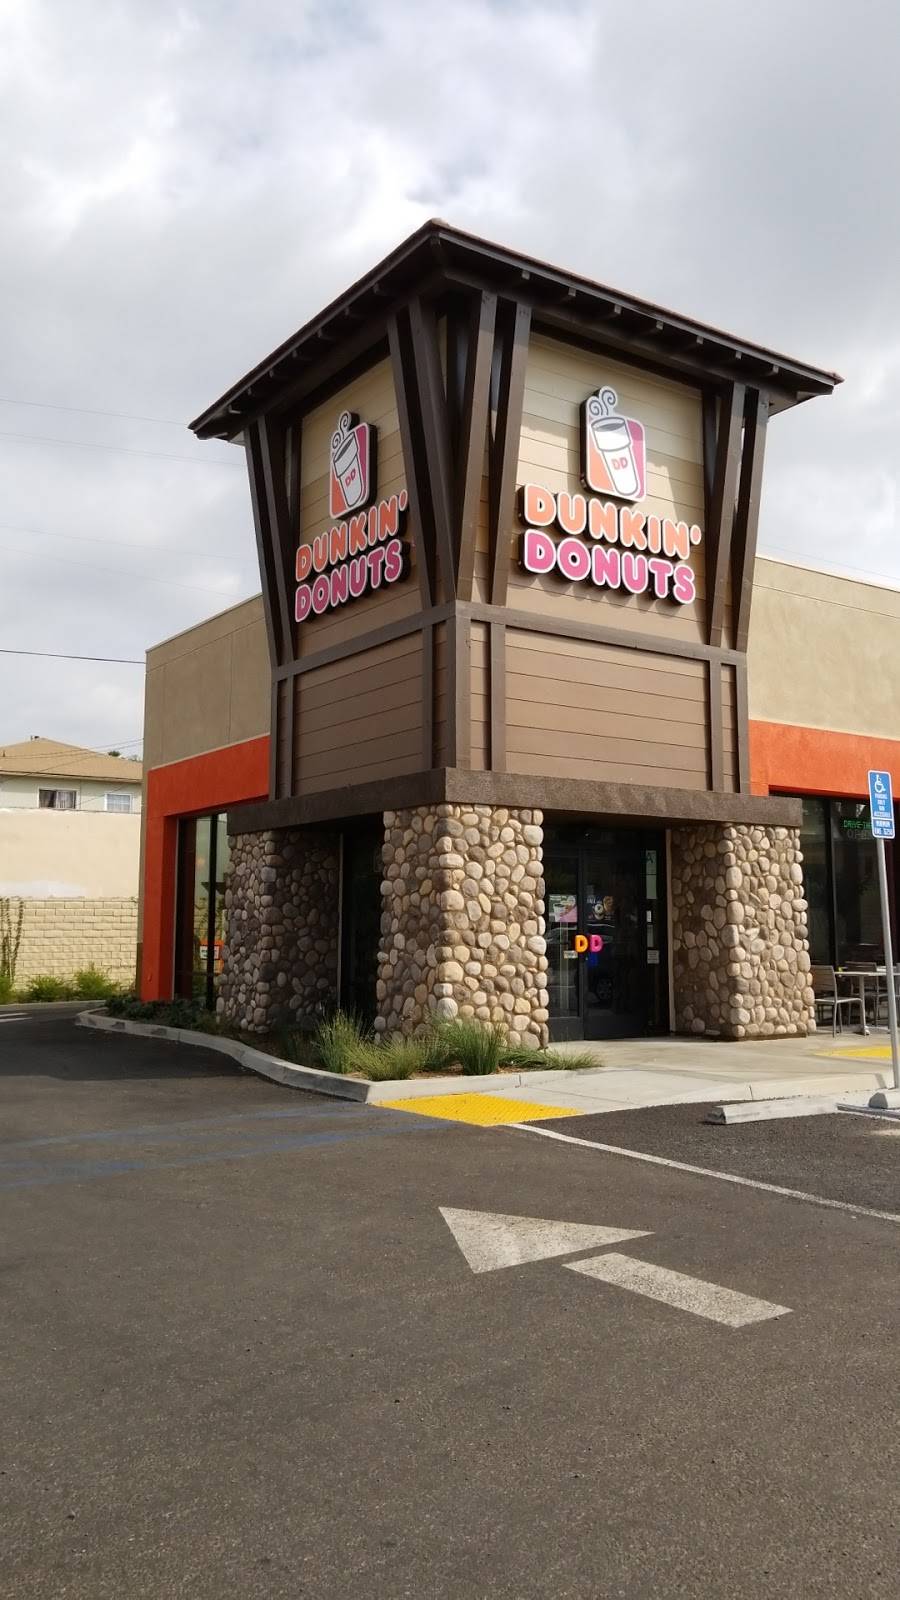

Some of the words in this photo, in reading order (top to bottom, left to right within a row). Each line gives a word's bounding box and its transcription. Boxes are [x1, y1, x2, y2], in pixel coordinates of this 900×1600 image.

[345, 468, 356, 487] DD
[611, 457, 628, 470] DD
[296, 489, 408, 582] DUNKIN'
[524, 484, 701, 560] DUNKIN'
[295, 539, 402, 622] DONUTS
[524, 529, 695, 604] DONUTS
[575, 934, 603, 953] DD
